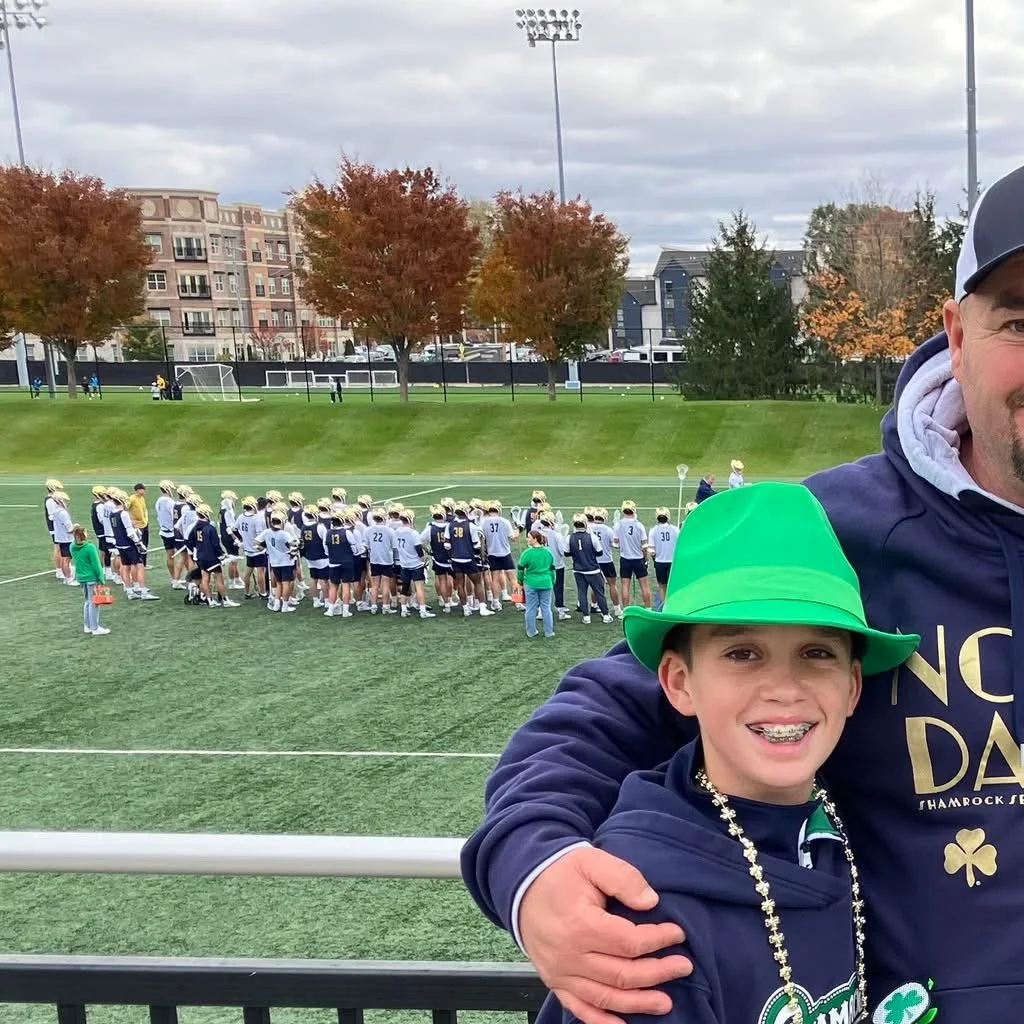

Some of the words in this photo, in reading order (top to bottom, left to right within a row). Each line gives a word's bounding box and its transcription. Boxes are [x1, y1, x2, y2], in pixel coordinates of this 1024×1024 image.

[489, 523, 499, 533] 37
[627, 526, 634, 536] 3
[373, 532, 383, 543] 22
[660, 531, 670, 542] 30
[918, 795, 1005, 811] SHAMROCK
